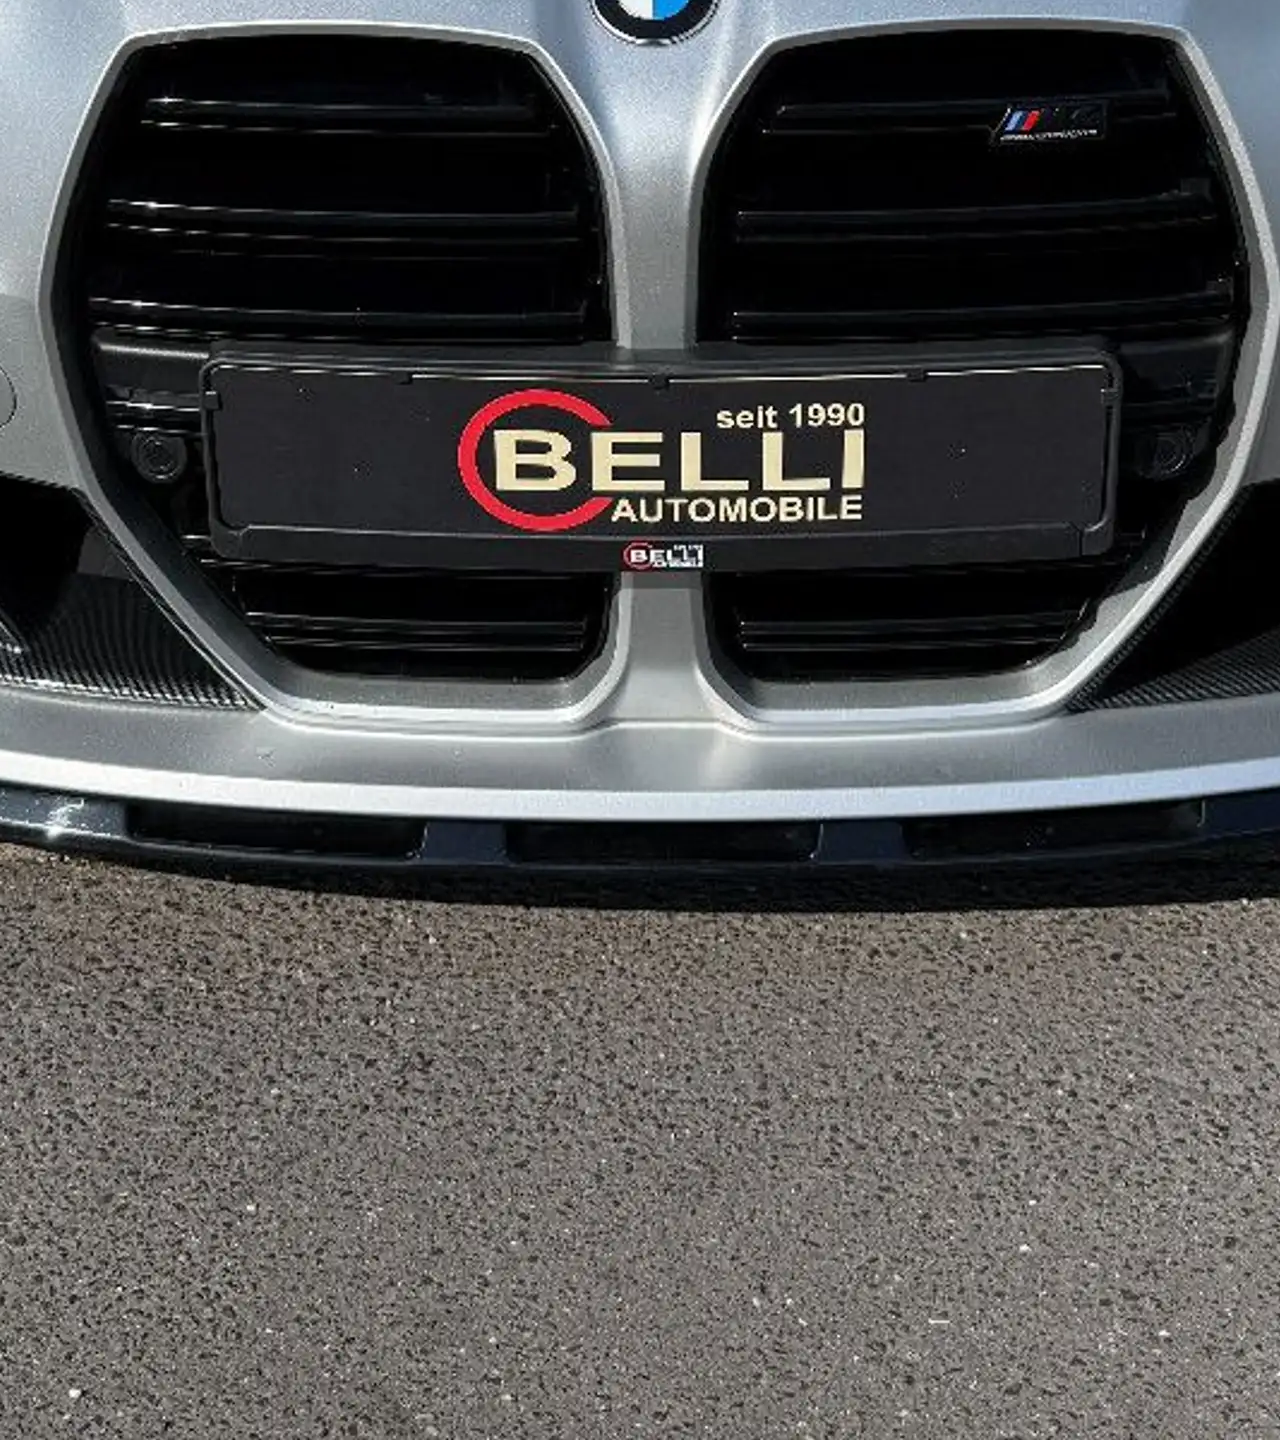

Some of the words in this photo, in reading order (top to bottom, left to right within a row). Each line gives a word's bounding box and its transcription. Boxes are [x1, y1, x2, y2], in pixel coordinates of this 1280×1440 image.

[717, 405, 778, 429] seit
[788, 403, 866, 428] 1990
[493, 428, 866, 491] BELLI
[611, 495, 863, 523] AUTOMOBILE
[630, 545, 704, 565] BELLI
